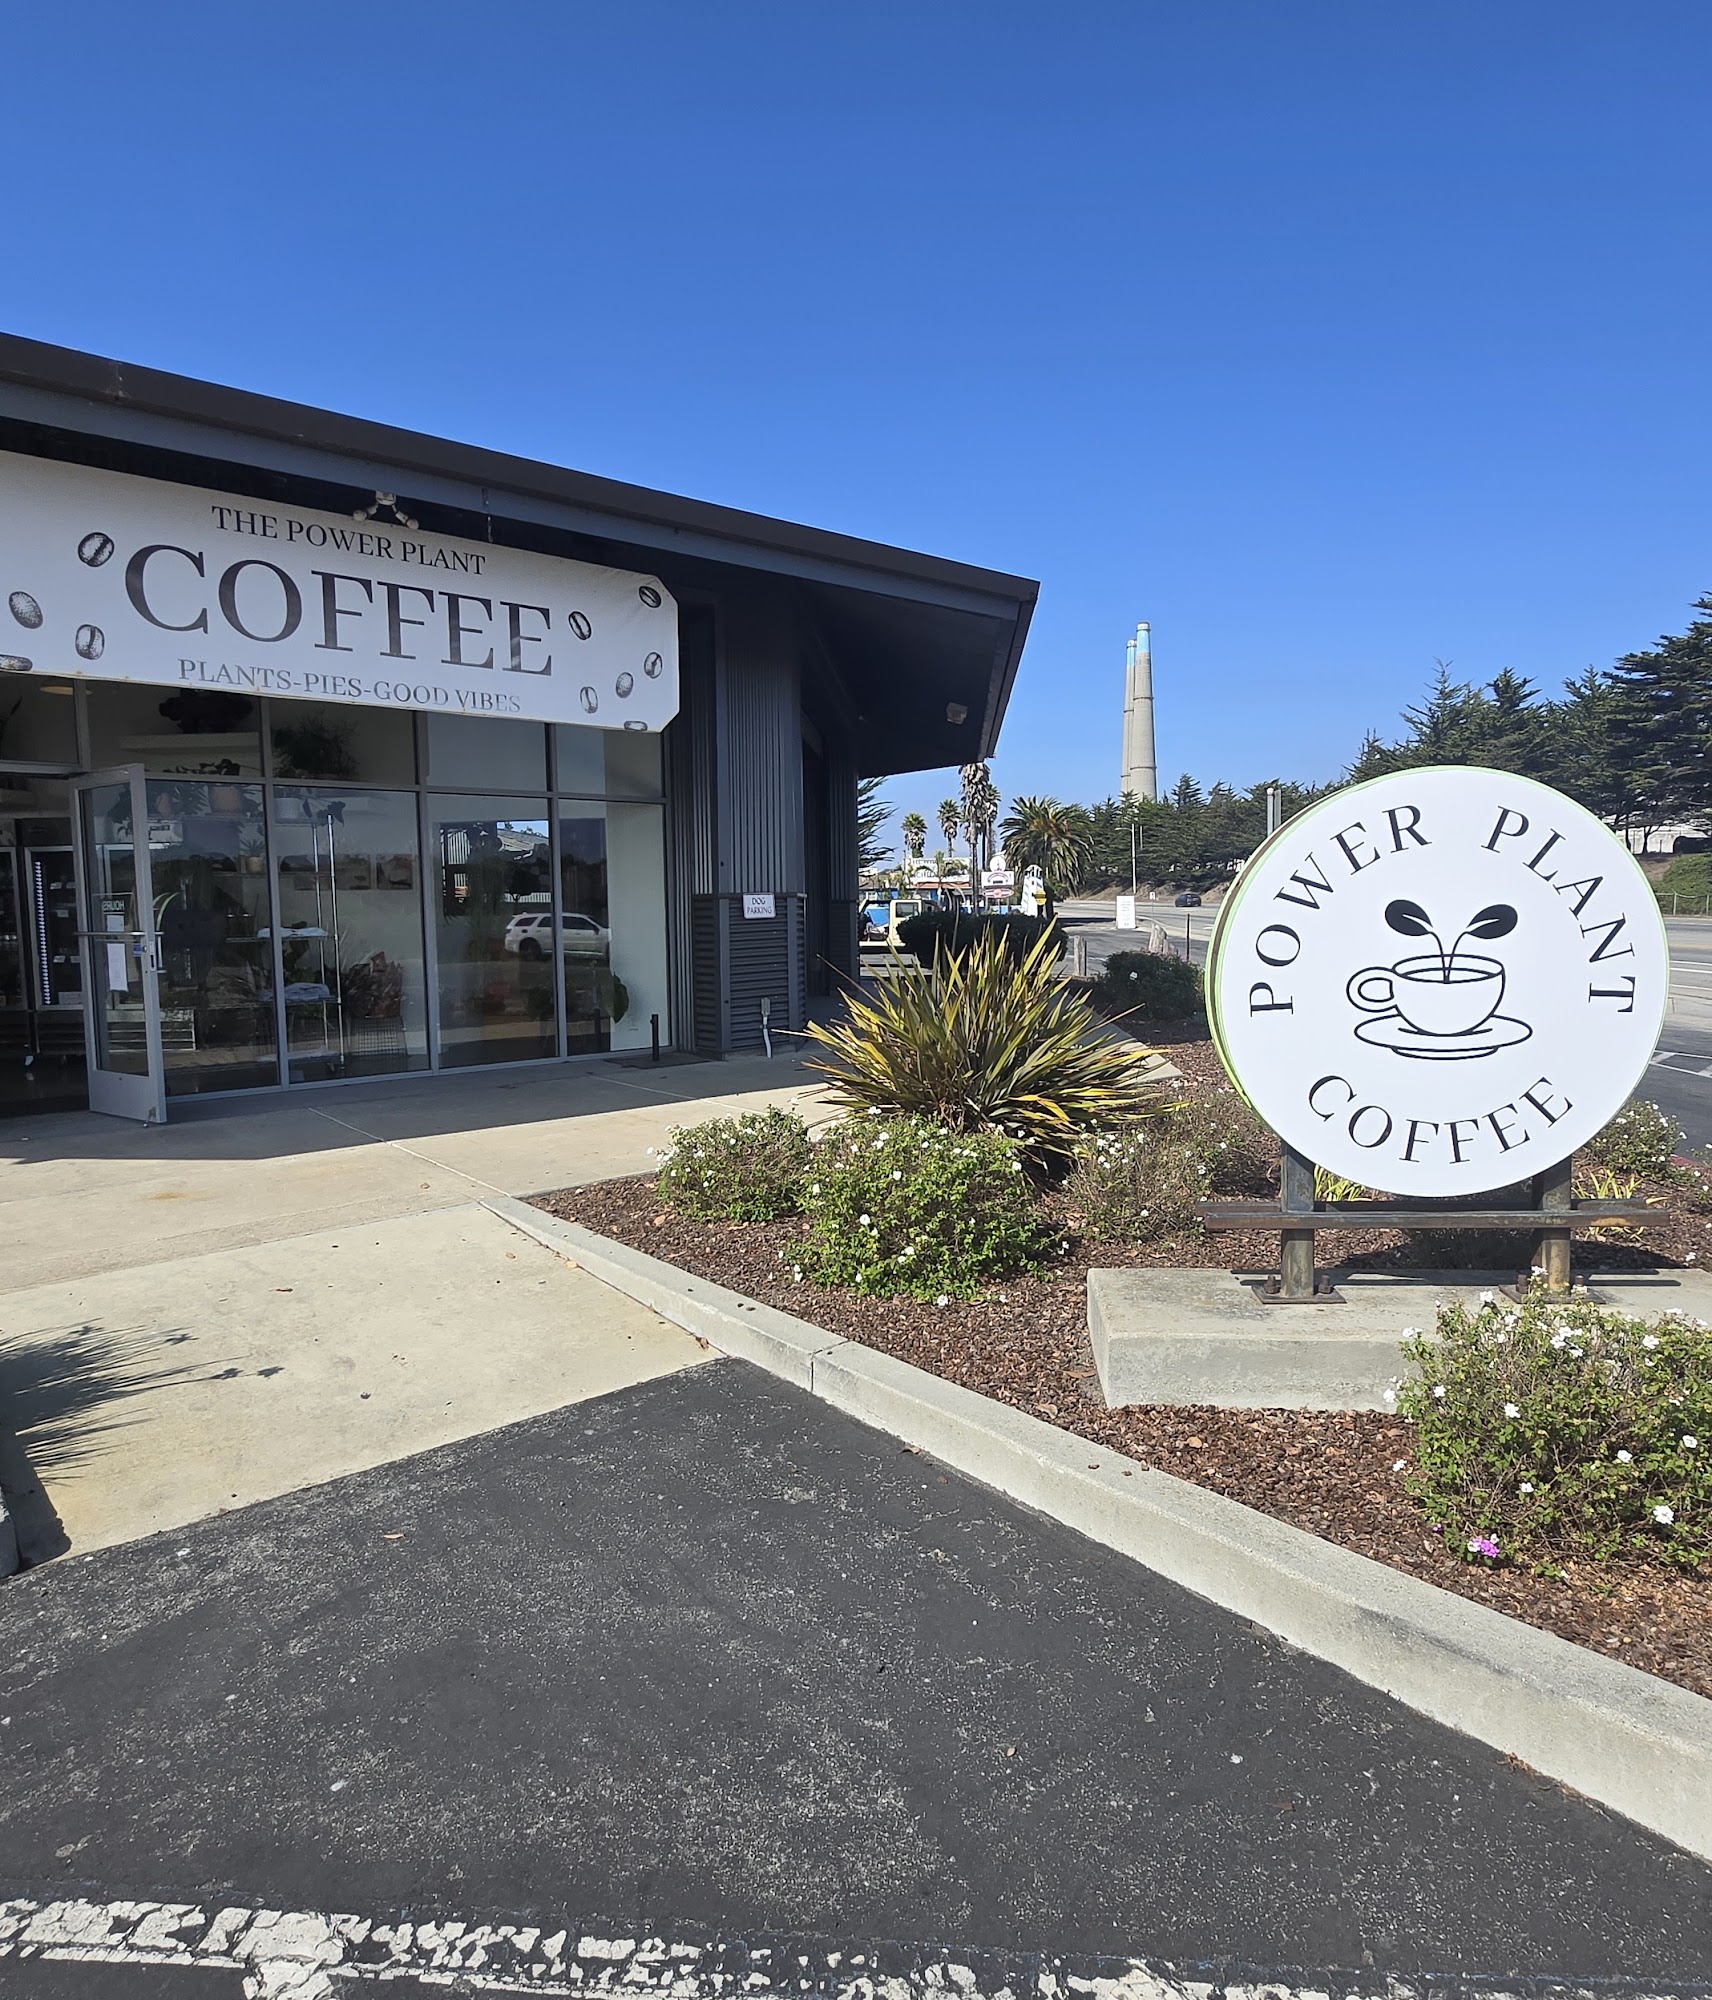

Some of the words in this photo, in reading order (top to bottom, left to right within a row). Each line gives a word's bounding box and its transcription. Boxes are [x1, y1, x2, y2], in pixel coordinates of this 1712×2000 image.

[212, 505, 278, 539] THE
[286, 519, 394, 560] POWER
[400, 540, 486, 576] PLANT
[124, 544, 552, 677] COFFEE
[455, 689, 521, 713] VIBES
[746, 906, 773, 914] PARKING
[751, 897, 766, 905] DOG
[1249, 805, 1433, 1018] POWER
[1480, 805, 1637, 1014] PLANT
[1308, 1075, 1574, 1165] COFFEE
